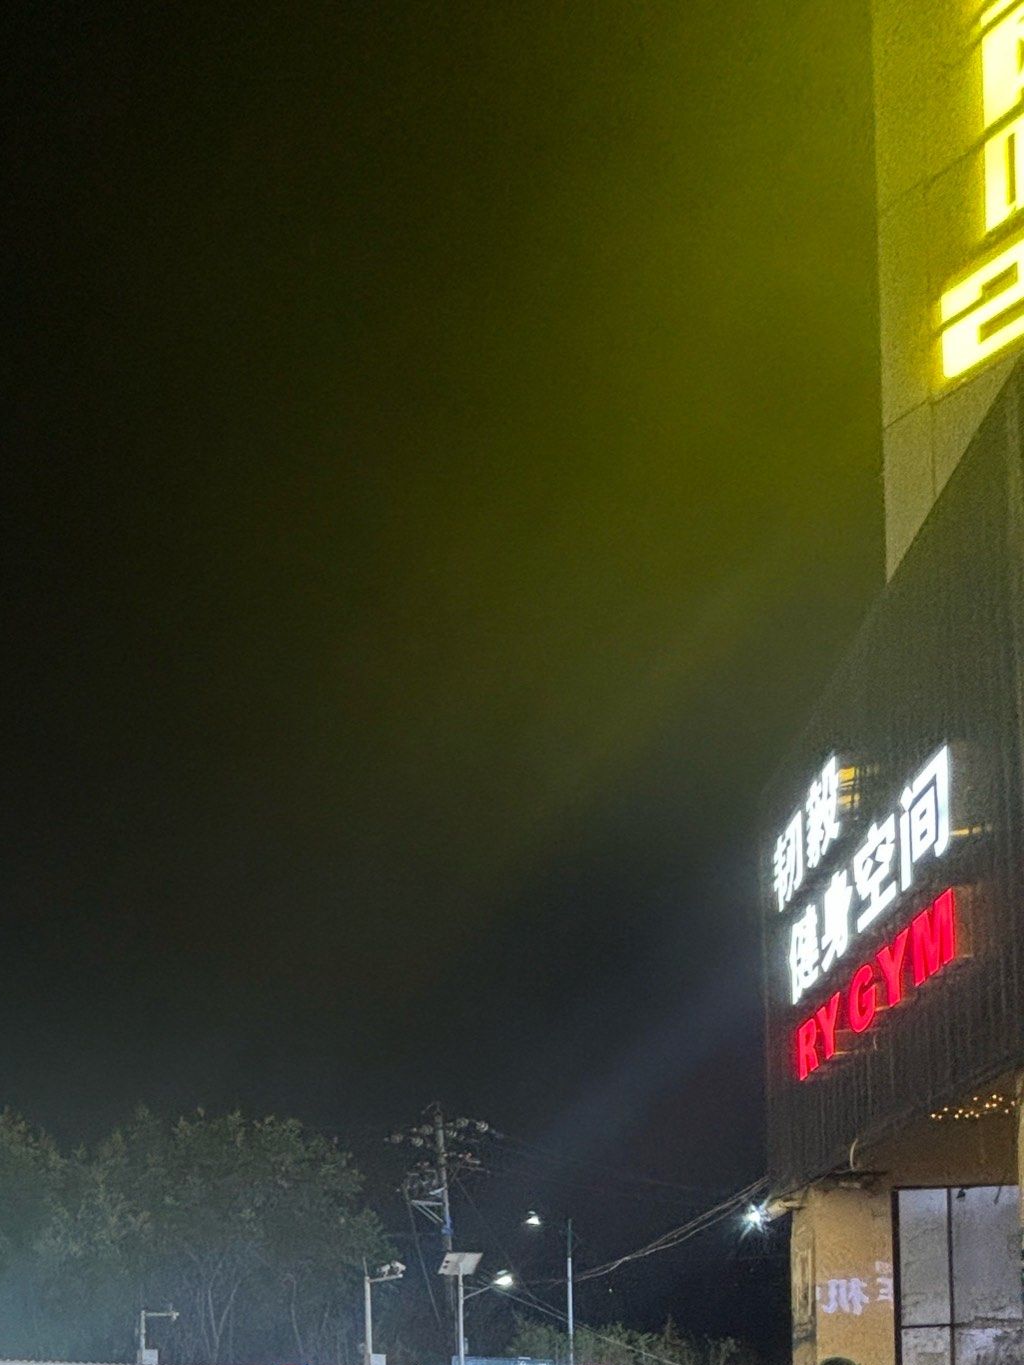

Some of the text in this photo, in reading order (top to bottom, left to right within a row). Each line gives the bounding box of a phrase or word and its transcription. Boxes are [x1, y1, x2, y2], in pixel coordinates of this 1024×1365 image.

[788, 744, 952, 1005] 健身空间
[798, 887, 957, 1081] RY GYM
